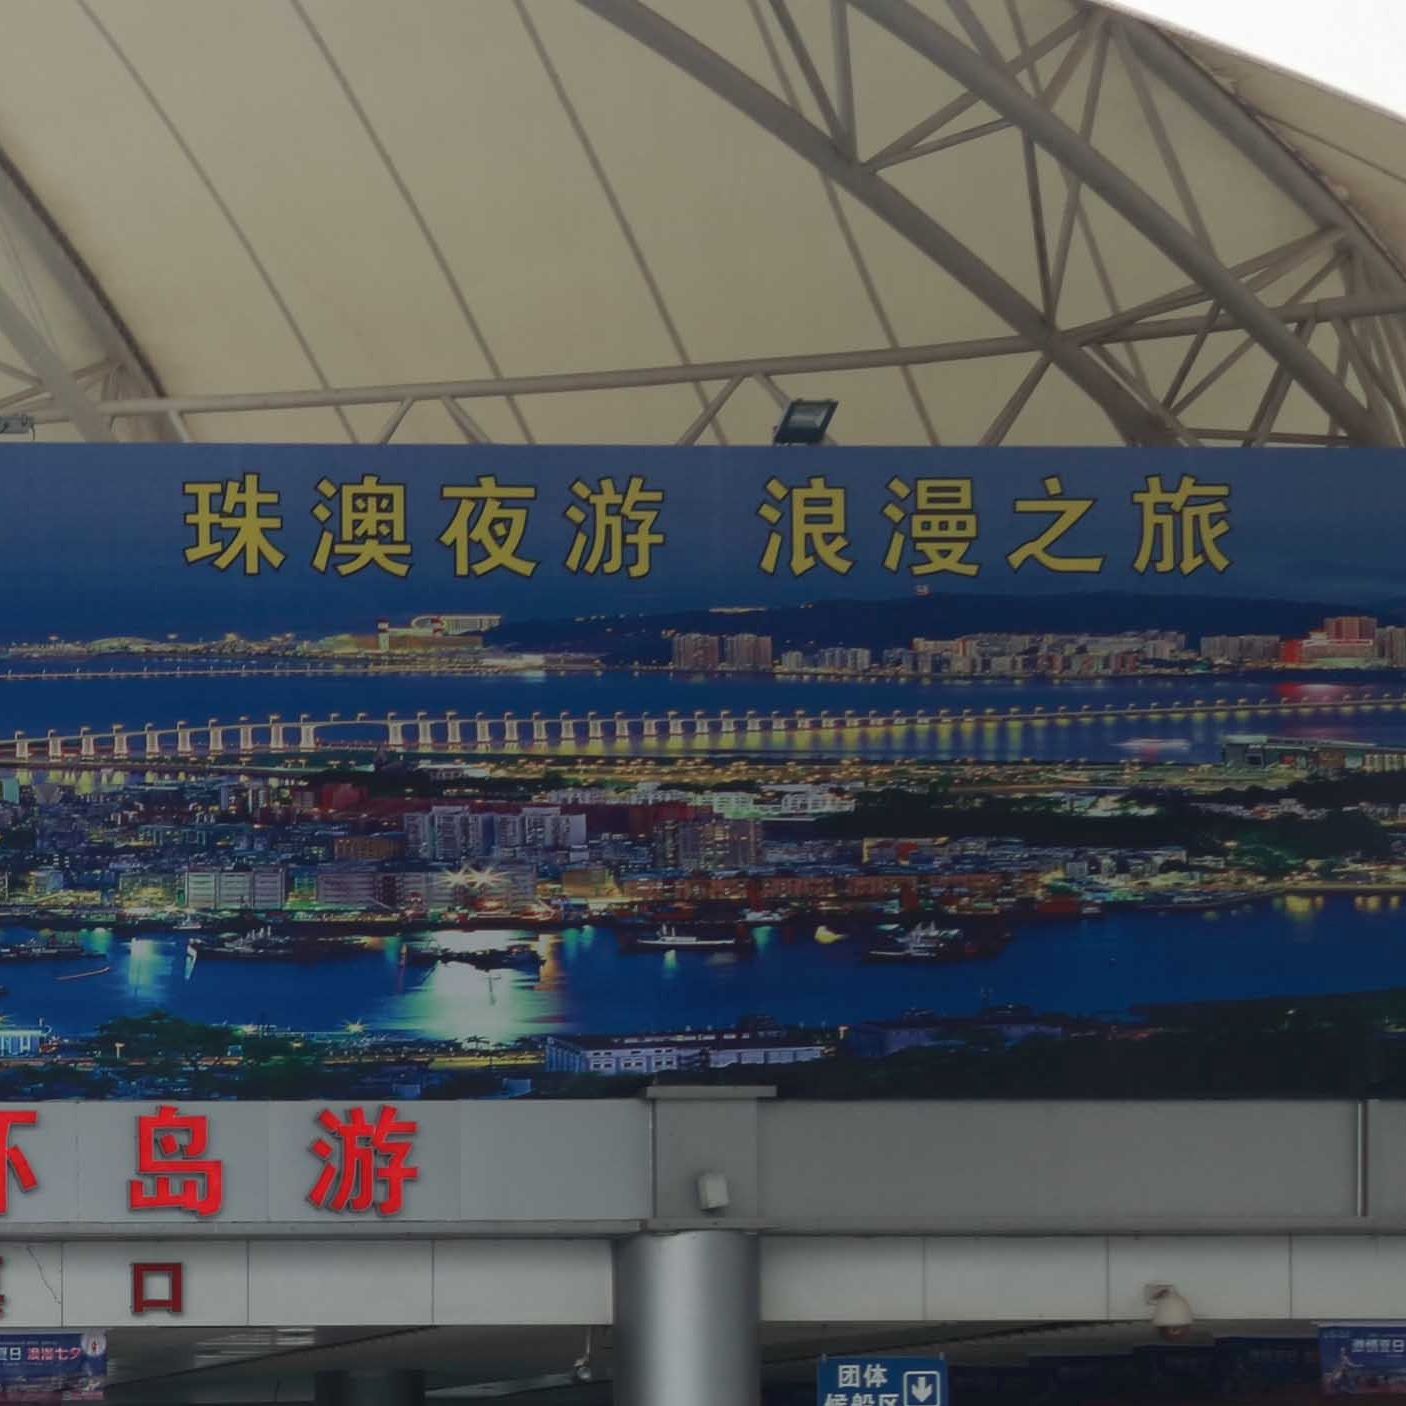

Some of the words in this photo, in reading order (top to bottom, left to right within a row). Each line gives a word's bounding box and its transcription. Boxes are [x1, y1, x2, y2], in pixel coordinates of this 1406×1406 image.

[181, 473, 666, 578] 珠澳夜游
[756, 473, 1234, 578] 浪漫之旅
[836, 1363, 889, 1388] 团体
